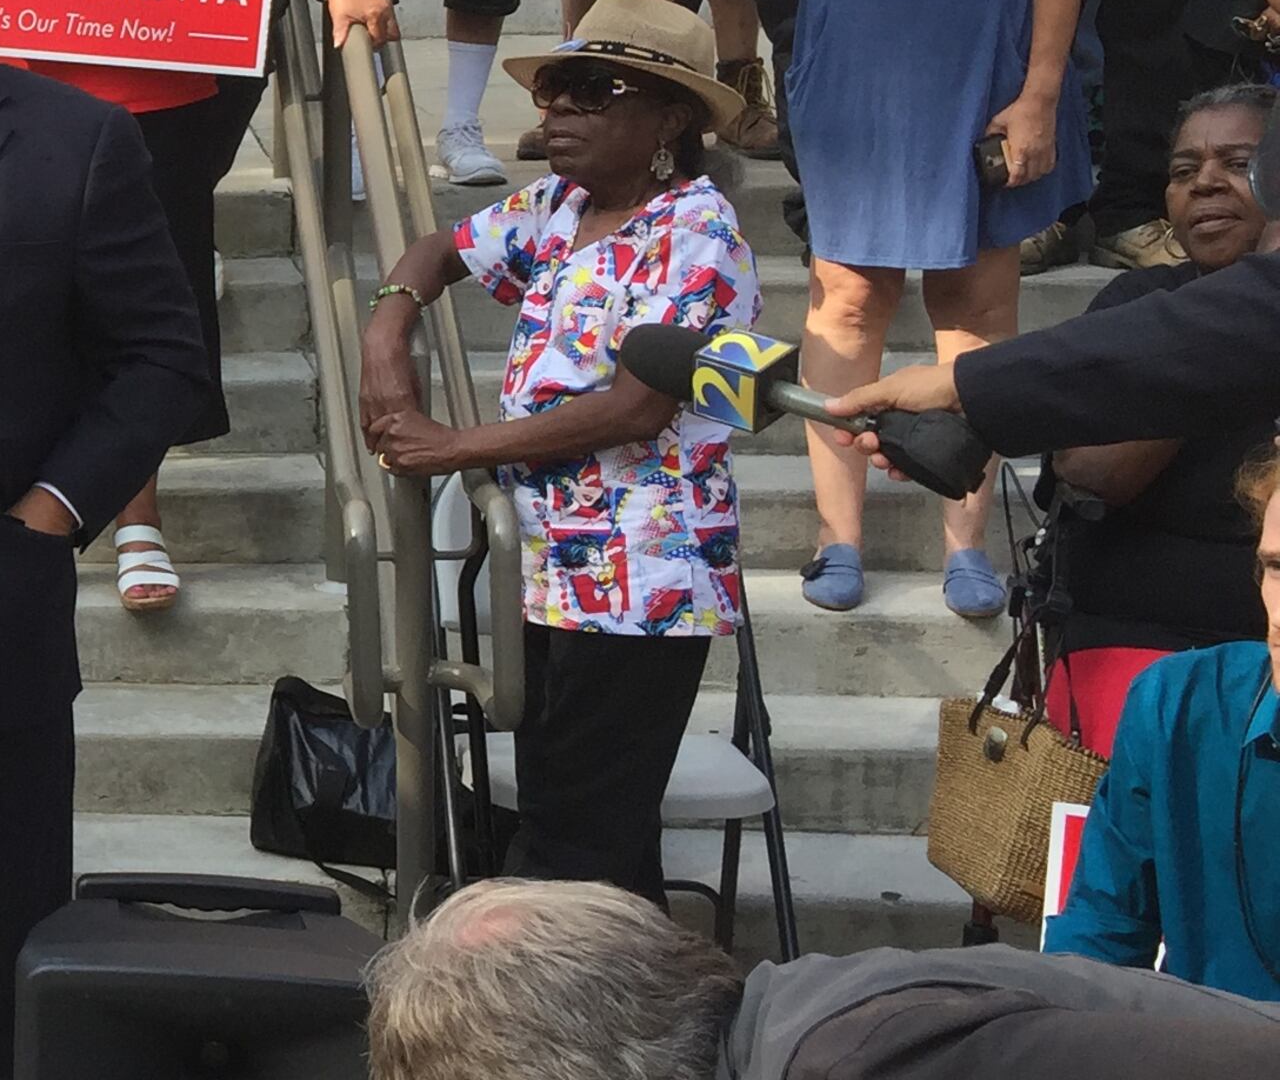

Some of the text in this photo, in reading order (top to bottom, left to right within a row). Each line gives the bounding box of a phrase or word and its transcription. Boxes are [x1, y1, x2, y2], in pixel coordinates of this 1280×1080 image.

[17, 8, 58, 34] Our
[65, 13, 114, 38] Time
[120, 19, 175, 43] Now!
[692, 366, 756, 432] 2
